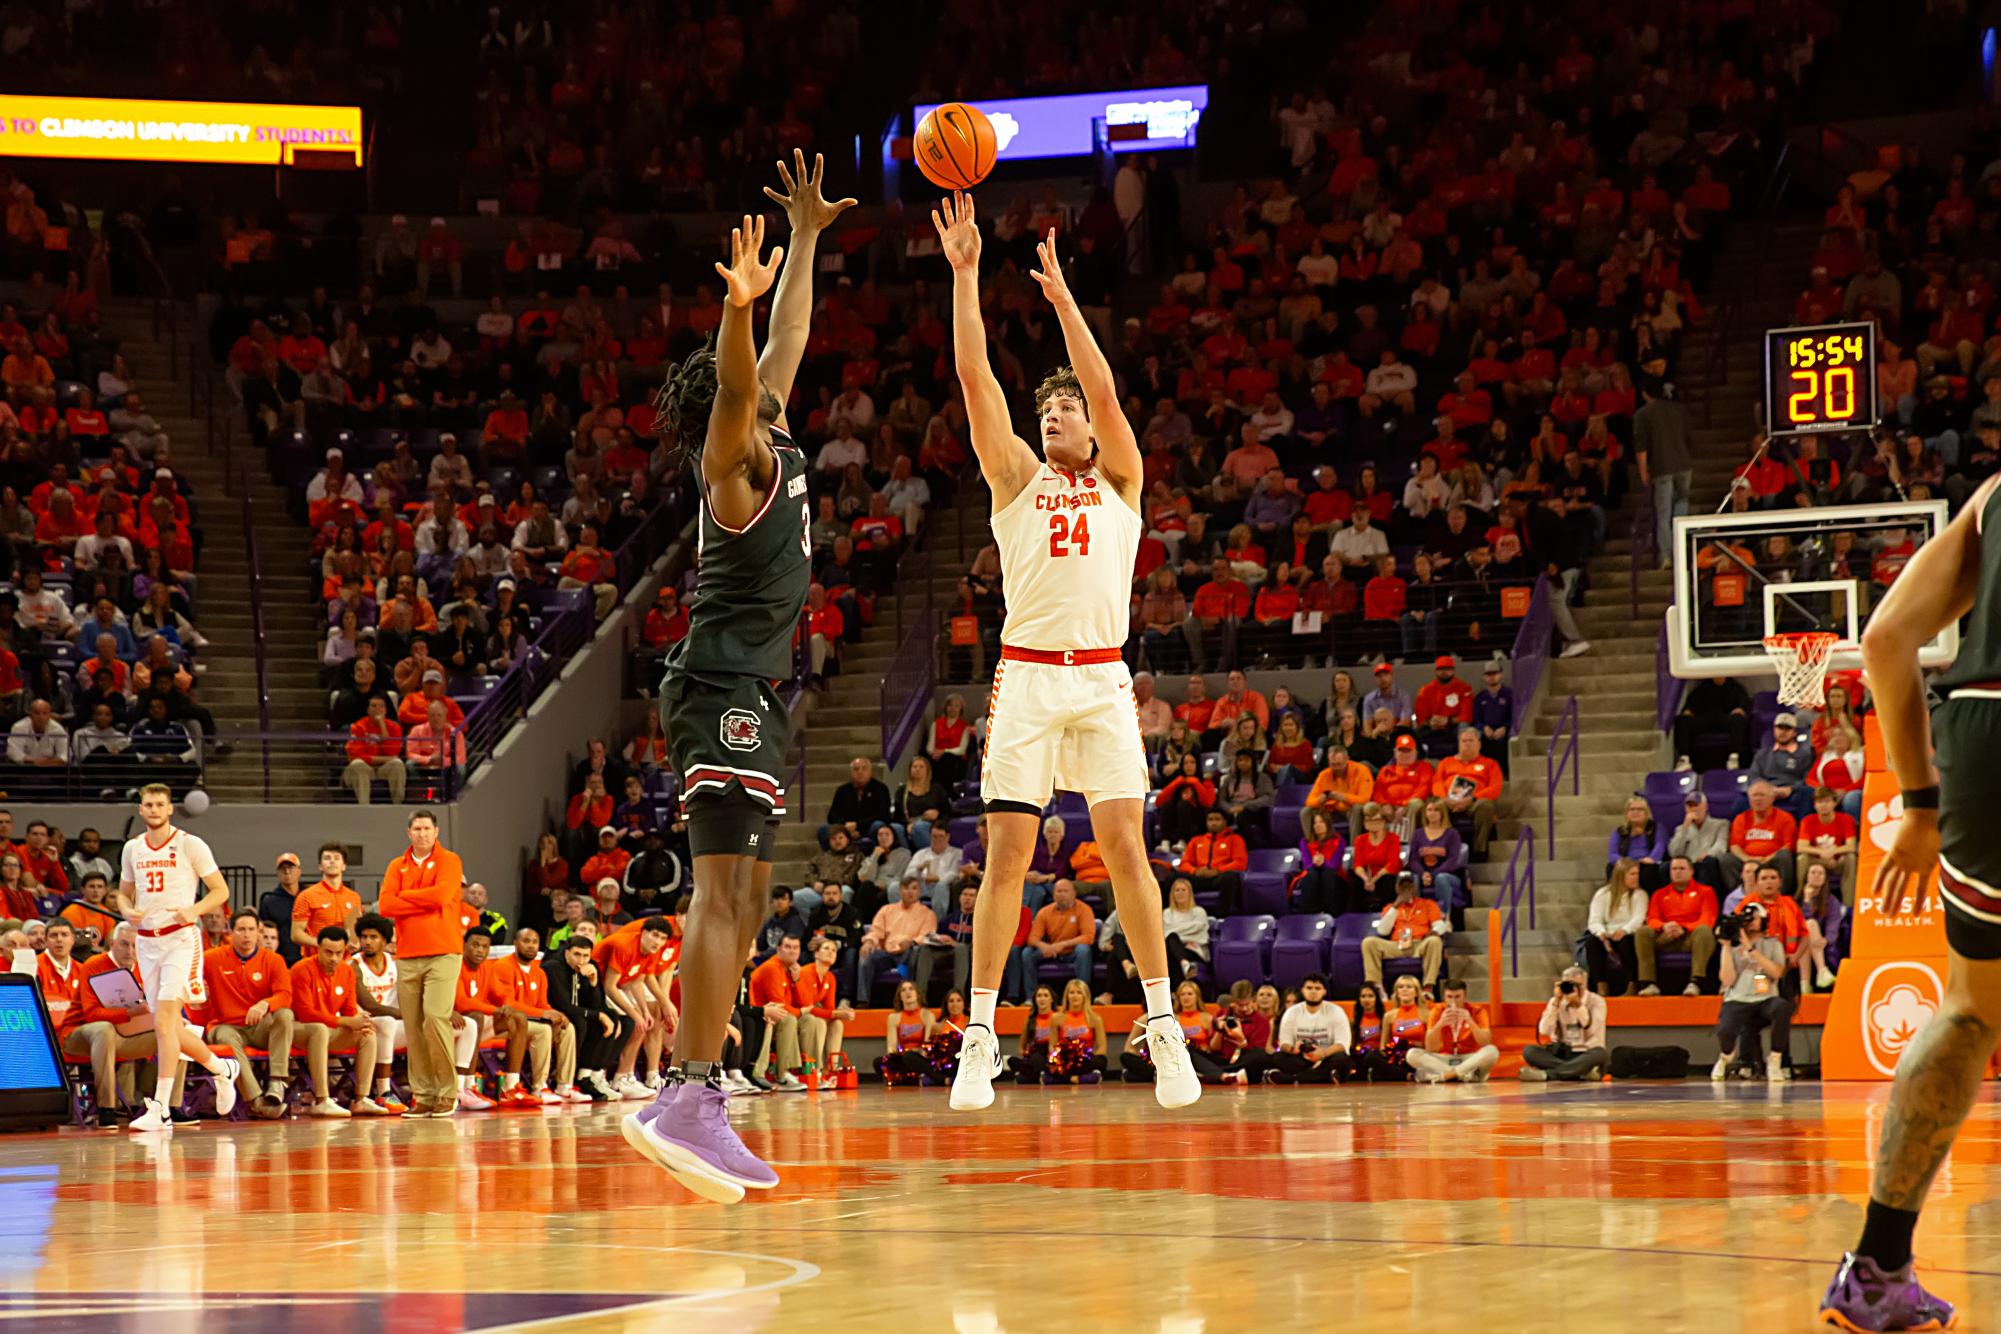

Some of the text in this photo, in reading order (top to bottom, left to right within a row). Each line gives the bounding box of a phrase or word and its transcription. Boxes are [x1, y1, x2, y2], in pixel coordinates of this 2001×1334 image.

[10, 118, 37, 135] TO
[39, 117, 135, 140] CLEMSON
[137, 121, 250, 143] UNIVERSITY
[1789, 335, 1863, 368] 15:54
[1789, 367, 1855, 422] 20
[1036, 491, 1102, 511] CLEMSON
[1050, 513, 1090, 557] 24
[1064, 650, 1074, 665] C
[136, 860, 177, 869] CLEMSON
[145, 871, 164, 893] 33
